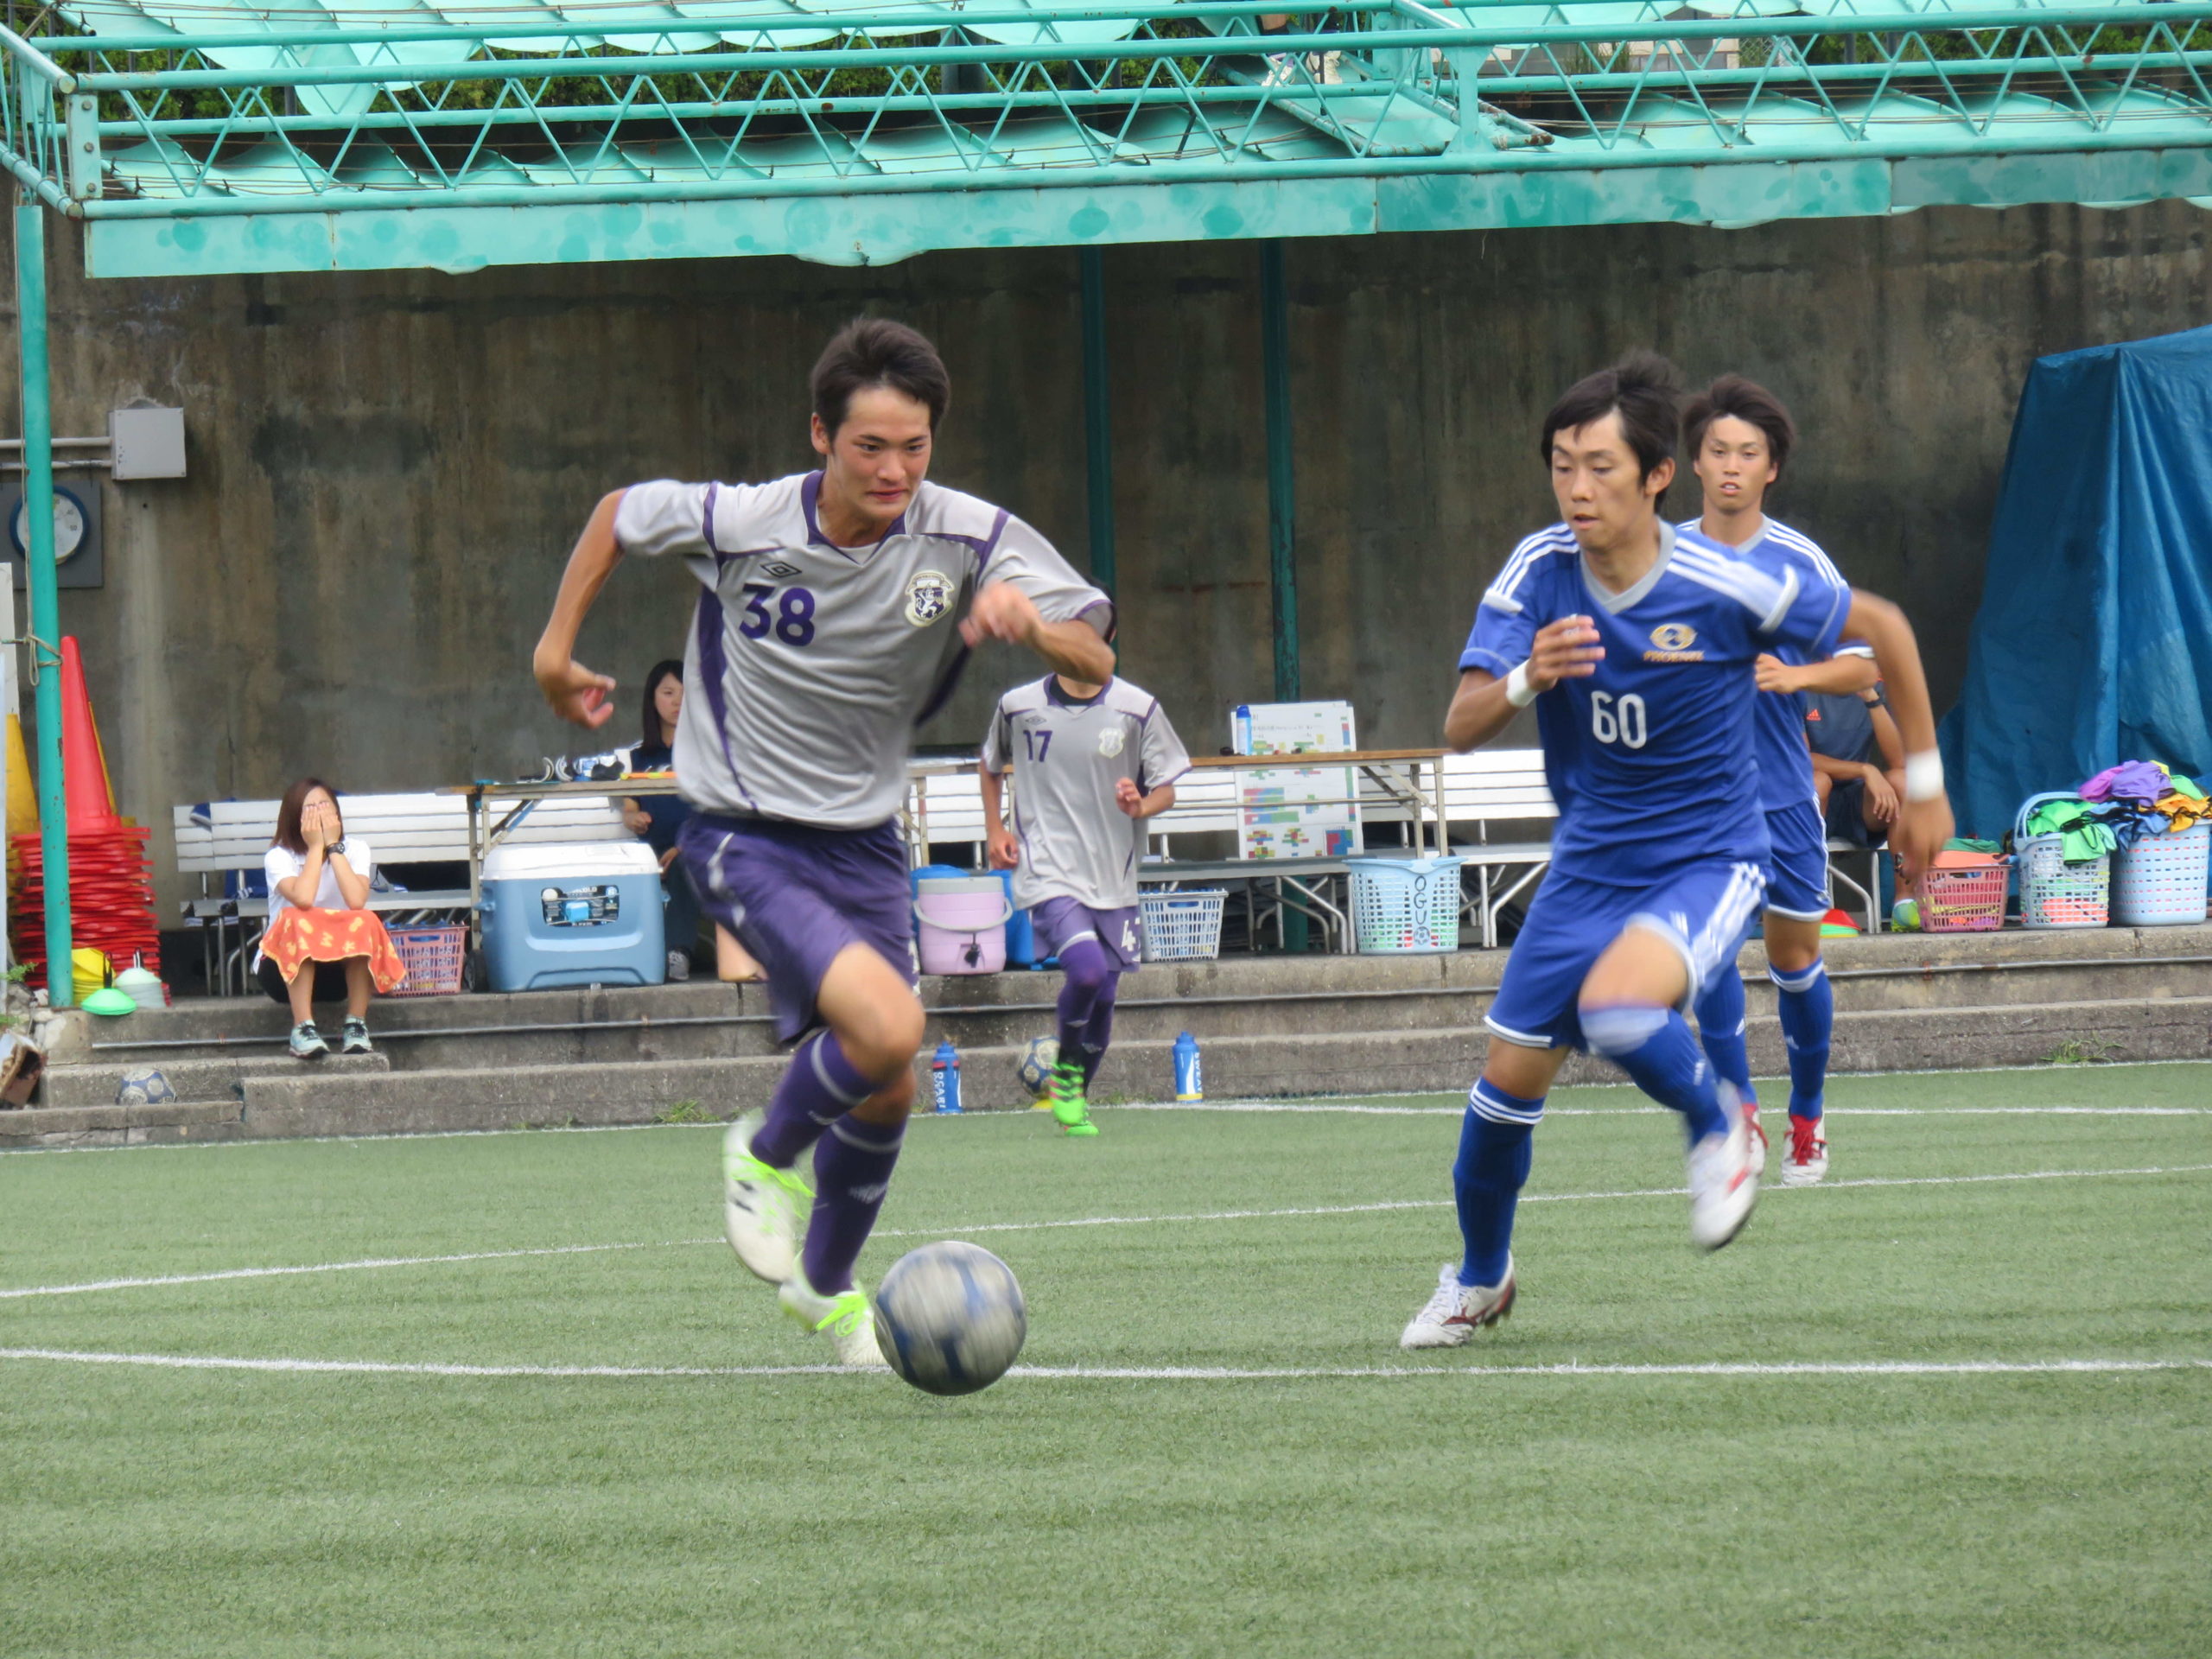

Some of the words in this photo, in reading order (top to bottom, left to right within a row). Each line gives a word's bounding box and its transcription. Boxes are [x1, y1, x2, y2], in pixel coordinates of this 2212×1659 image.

[739, 582, 816, 646] 38
[1023, 729, 1053, 762] 17
[1591, 690, 1647, 749] 60
[1413, 874, 1427, 925] OGU
